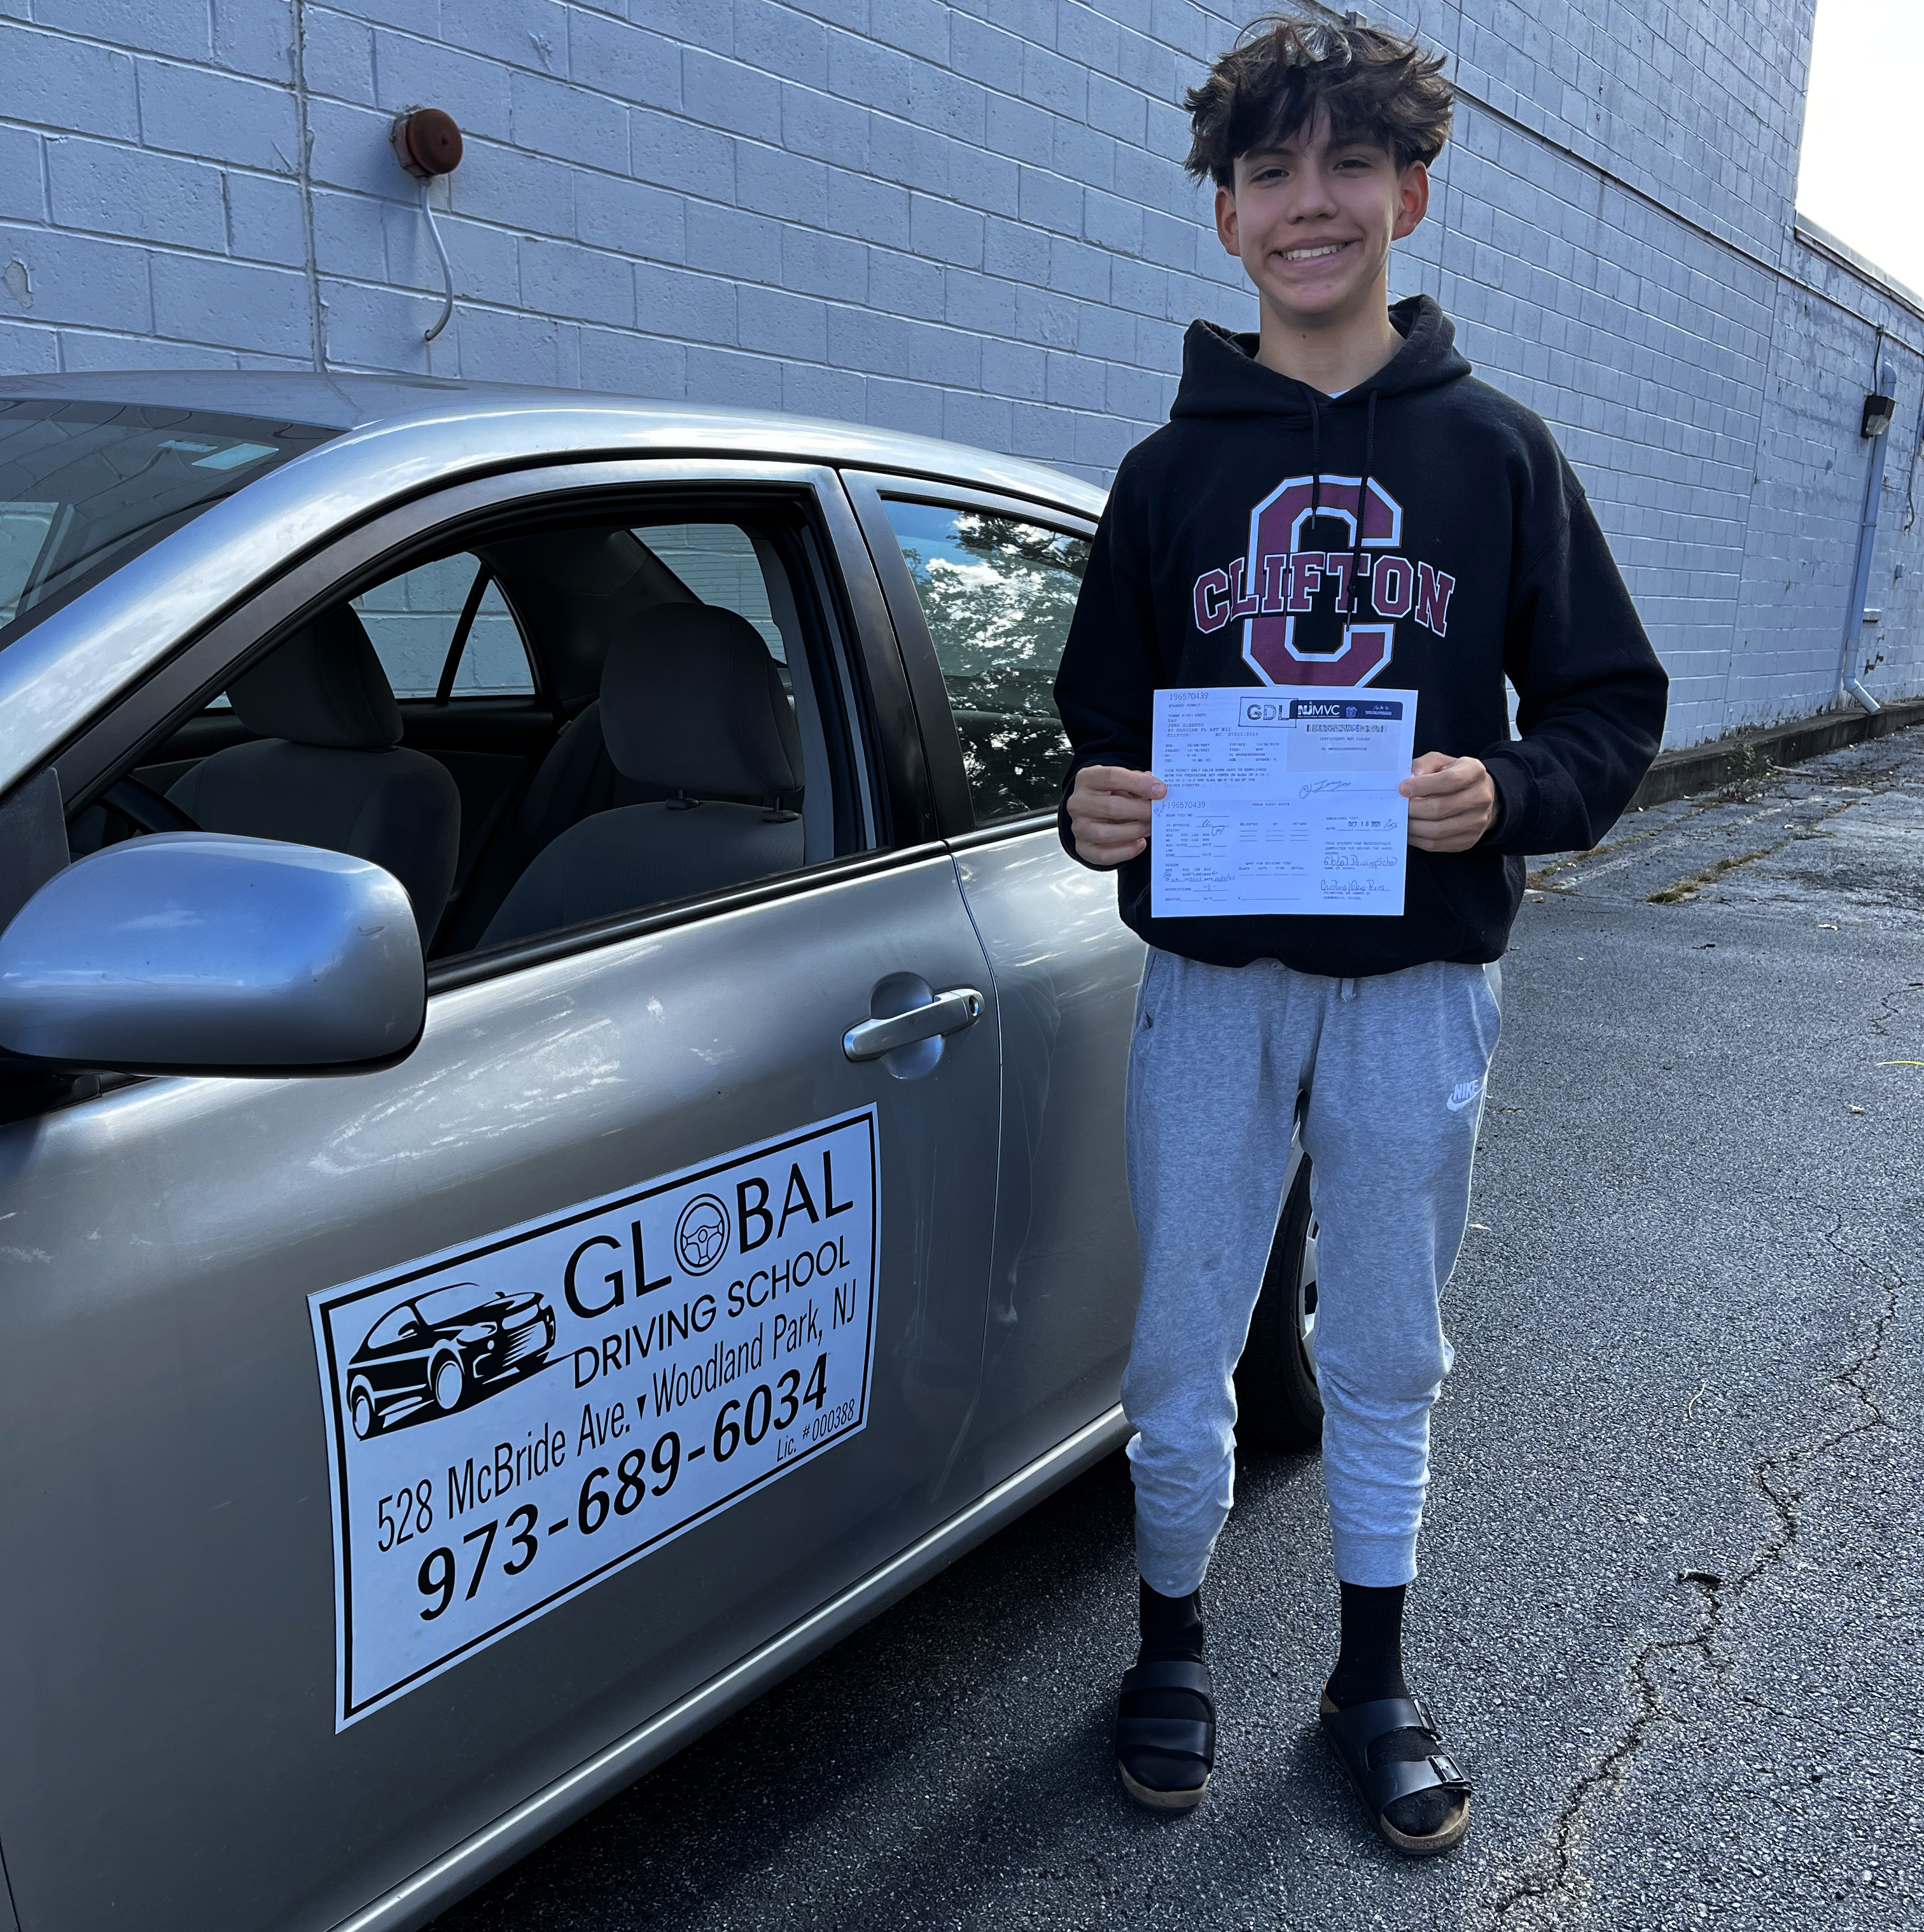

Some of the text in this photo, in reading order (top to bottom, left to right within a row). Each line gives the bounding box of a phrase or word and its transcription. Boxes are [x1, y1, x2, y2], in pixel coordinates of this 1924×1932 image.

[1194, 552, 1456, 637] CLIFTON
[1169, 692, 1209, 701] 196570439
[1247, 704, 1290, 720] GDL
[1453, 1079, 1479, 1100] NIKE
[573, 1235, 851, 1389] DRIVING SCHOOL
[378, 1278, 857, 1553] 528 McBride Ave. Woodland Park, NJ
[776, 1435, 797, 1463] Lic.
[417, 1352, 828, 1621] 973-689-6034
